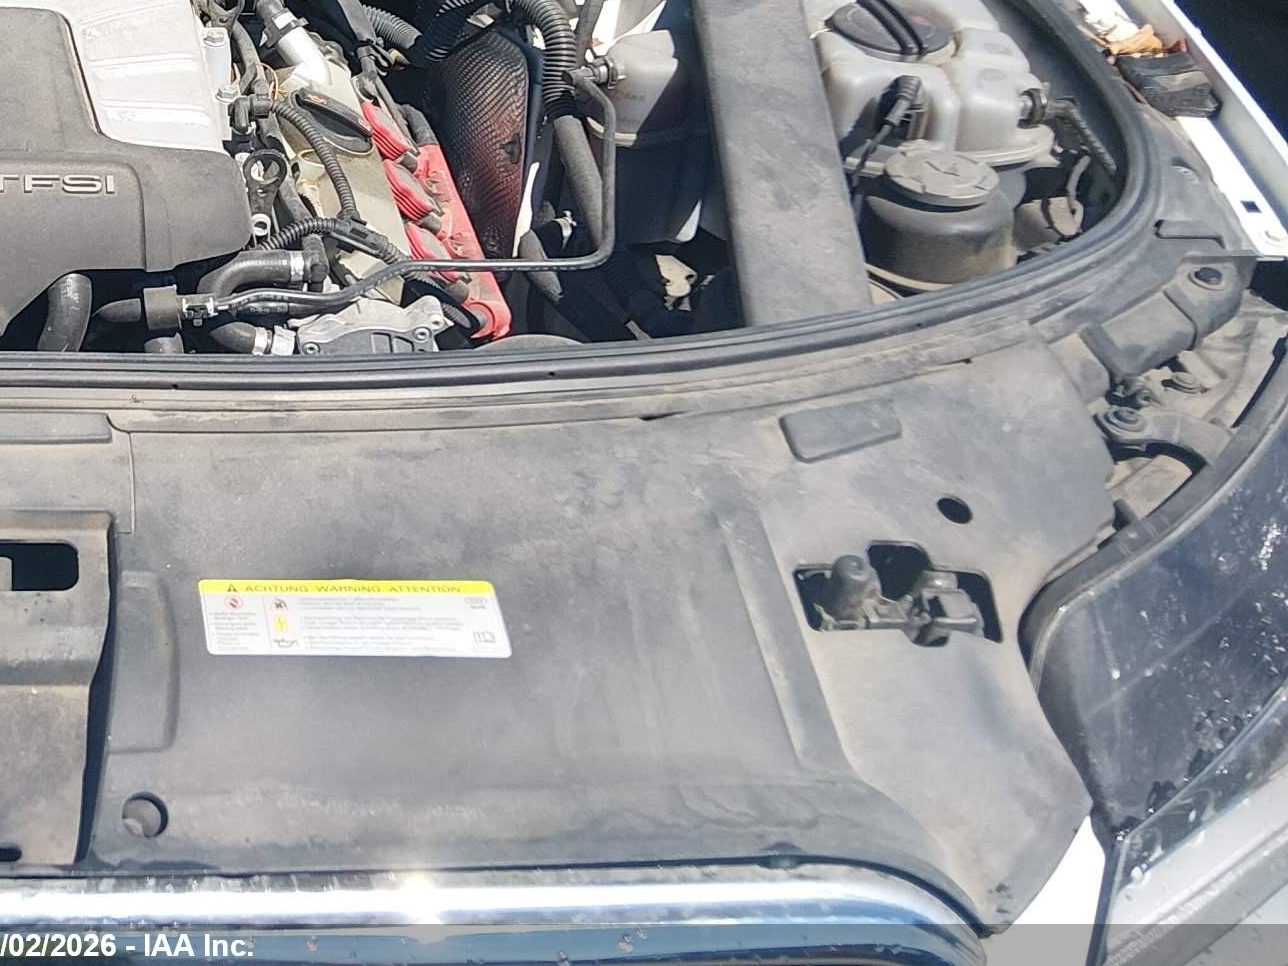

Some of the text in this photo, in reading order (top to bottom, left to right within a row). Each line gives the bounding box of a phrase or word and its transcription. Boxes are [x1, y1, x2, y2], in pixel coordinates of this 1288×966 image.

[244, 585, 462, 594] ACHTUNG WARNING ATTENTION
